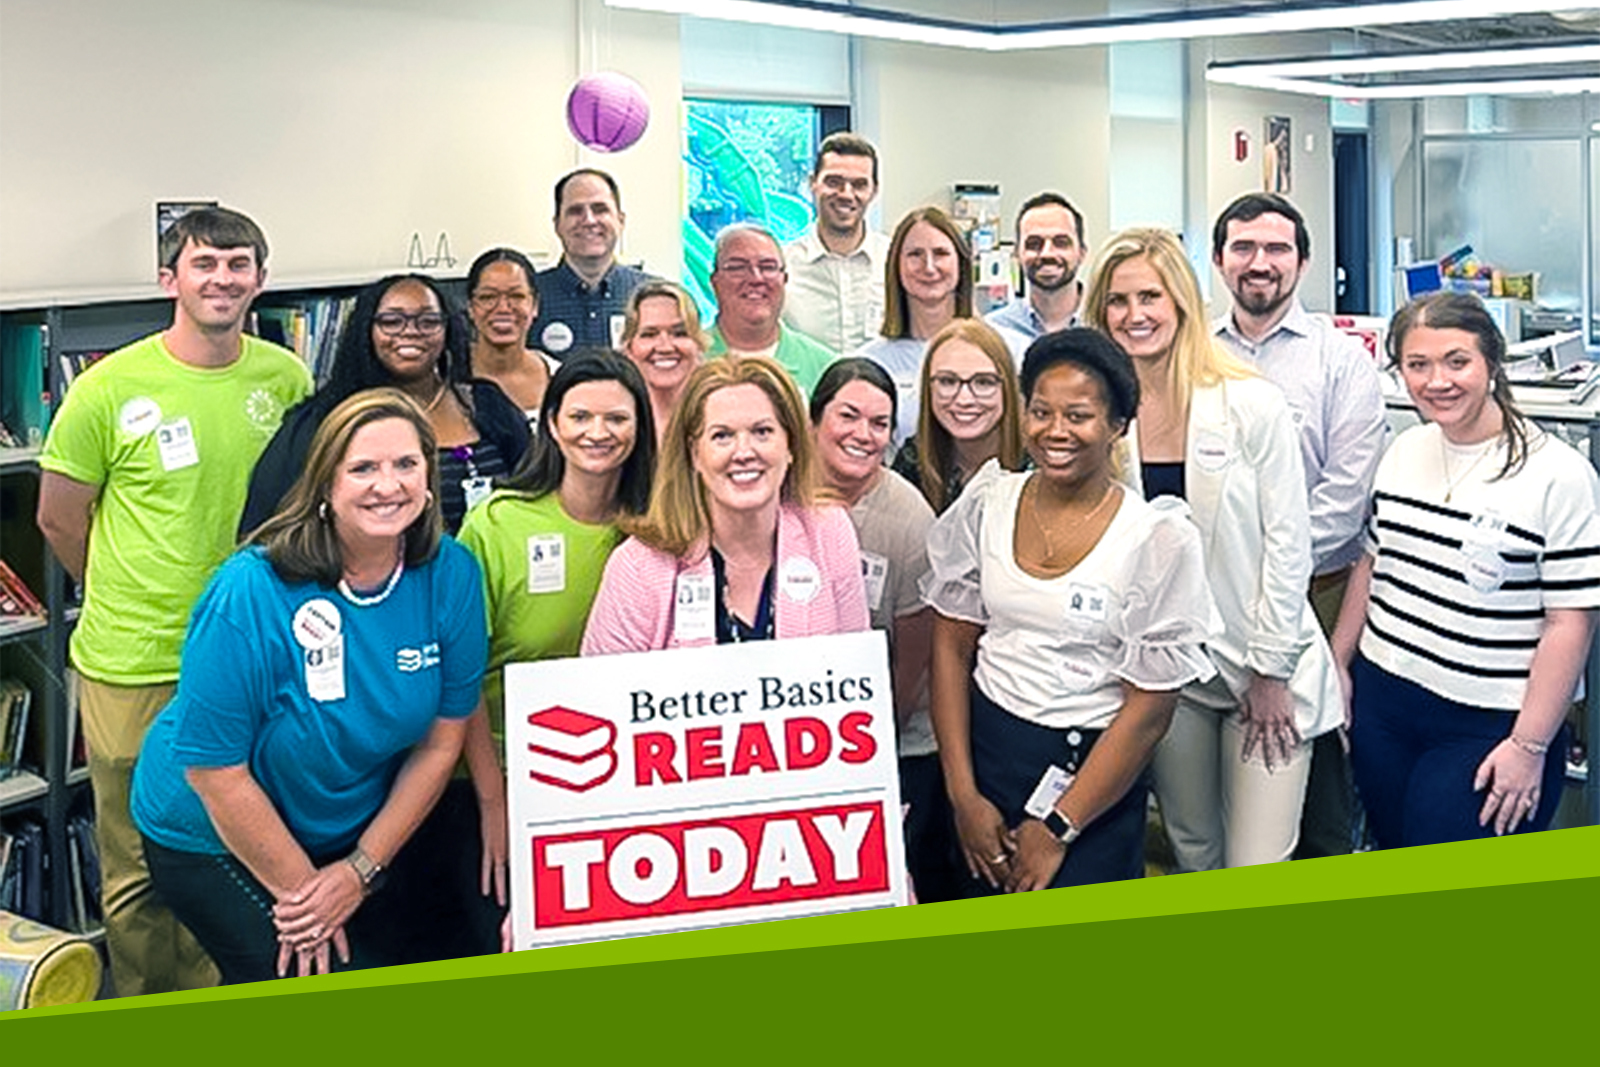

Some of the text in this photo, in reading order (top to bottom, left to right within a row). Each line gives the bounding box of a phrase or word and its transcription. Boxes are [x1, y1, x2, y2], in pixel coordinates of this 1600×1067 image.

[629, 670, 874, 723] Better Basics
[633, 711, 878, 787] READS
[544, 810, 875, 913] TODAY
